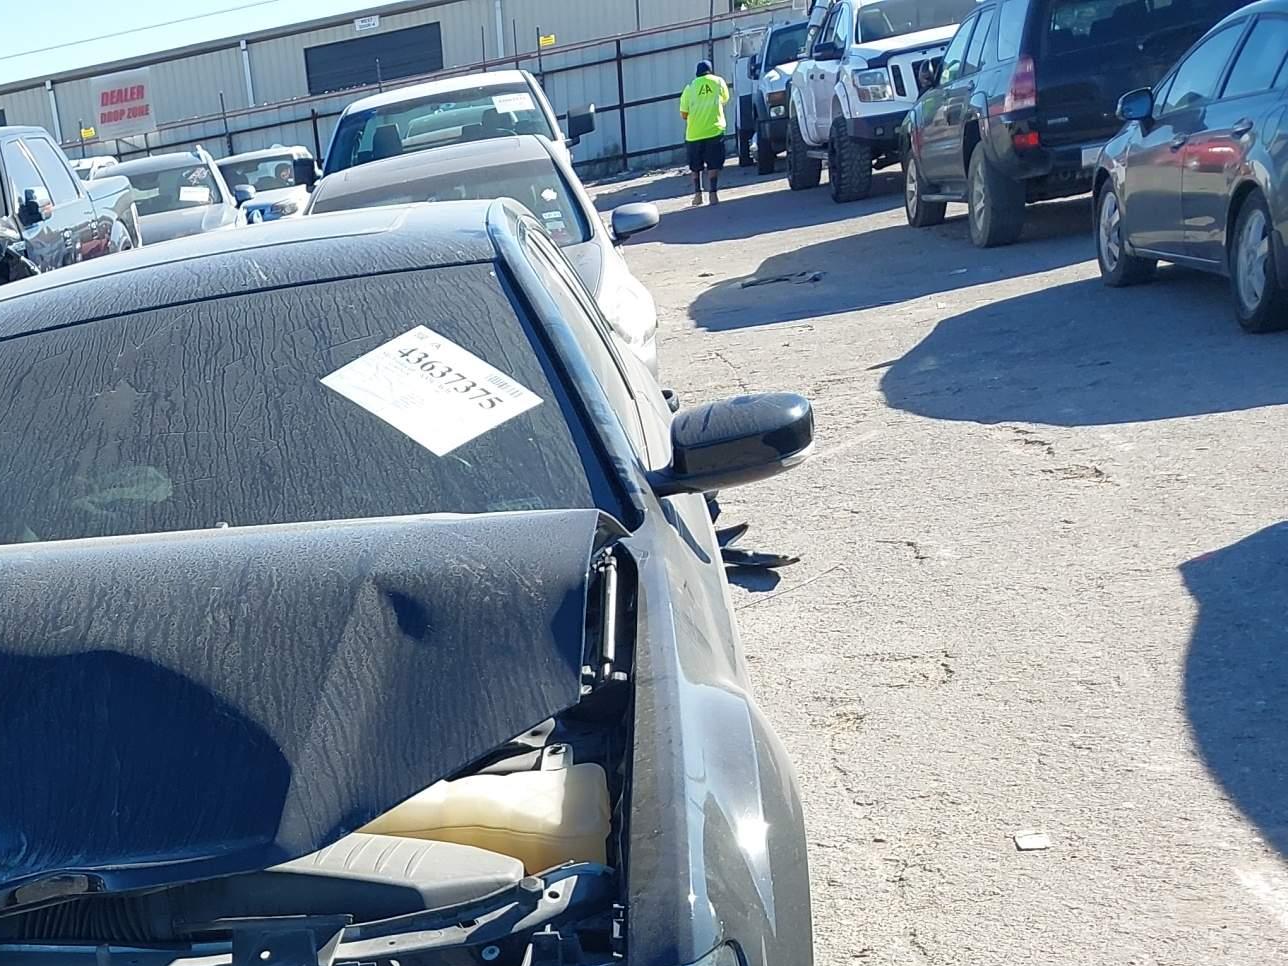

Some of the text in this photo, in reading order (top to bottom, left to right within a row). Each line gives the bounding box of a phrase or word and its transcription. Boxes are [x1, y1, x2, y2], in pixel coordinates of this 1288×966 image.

[100, 84, 145, 107] DEALER
[100, 104, 150, 124] DROP ZONE
[397, 346, 504, 410] 43637375
